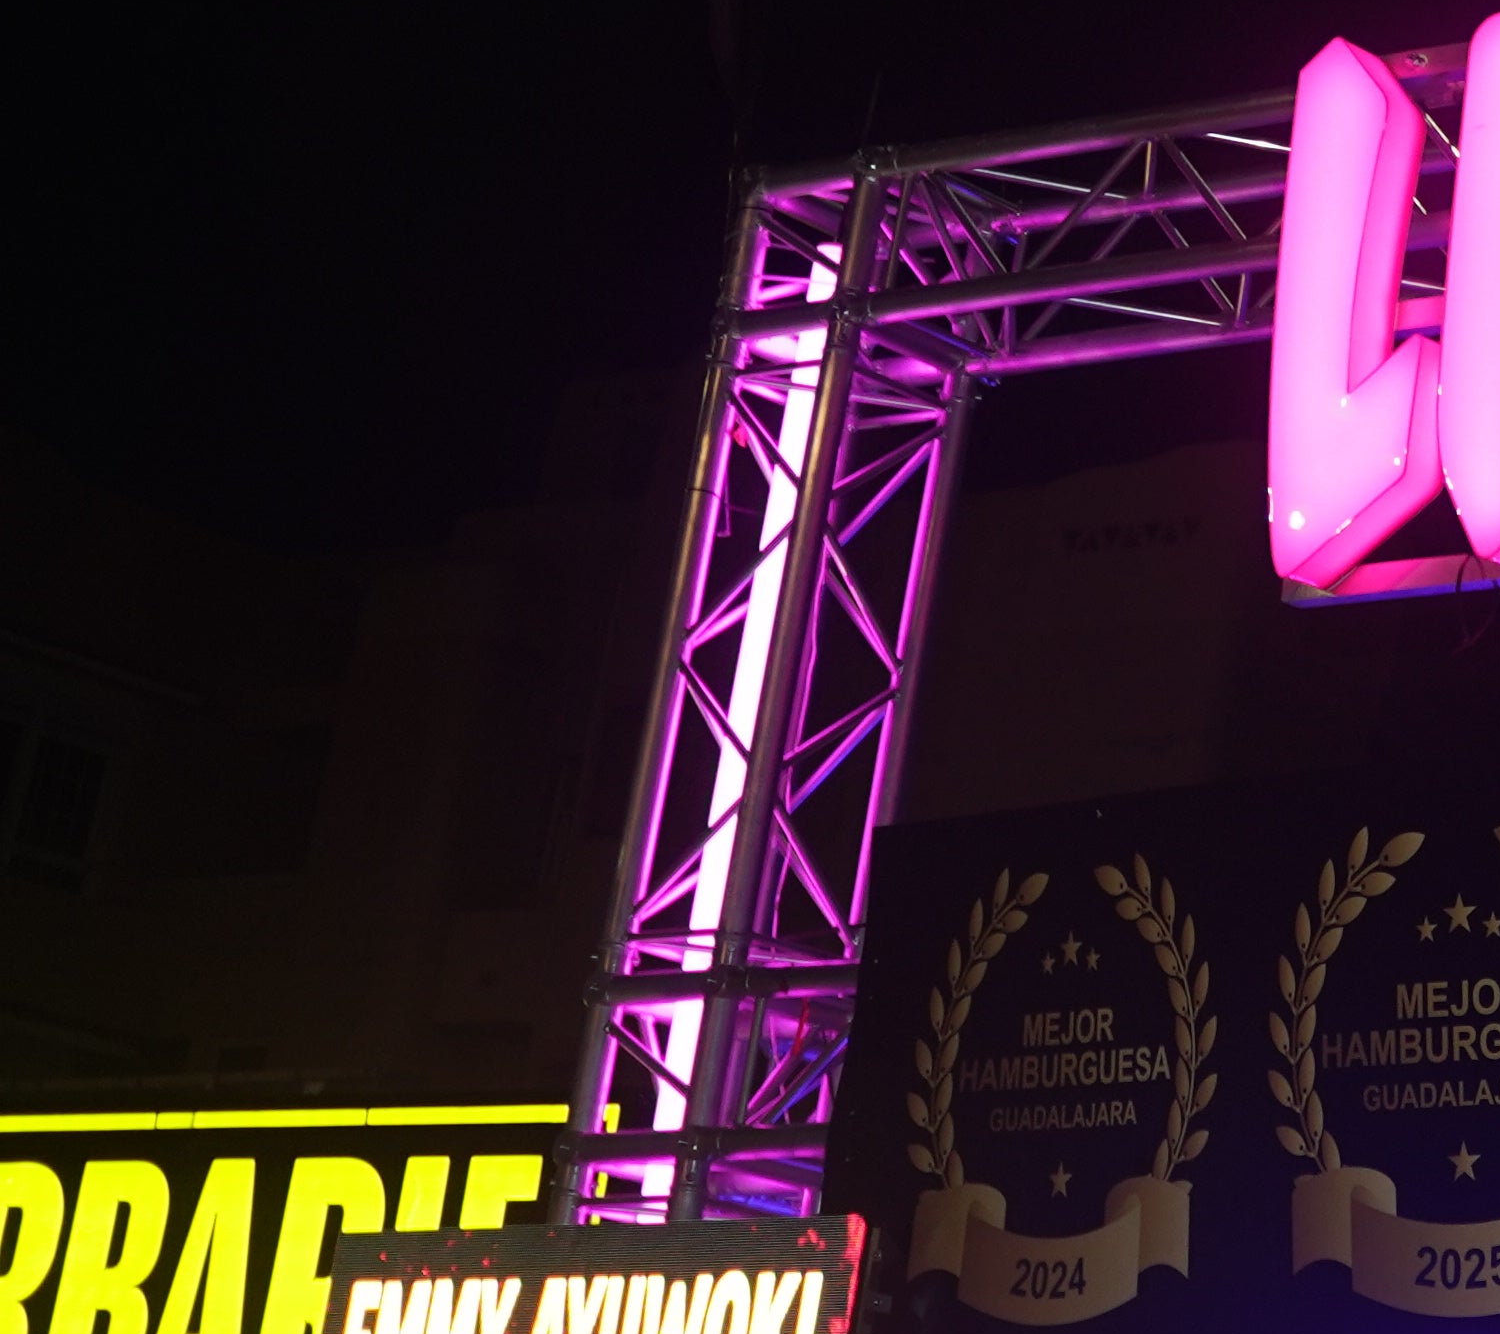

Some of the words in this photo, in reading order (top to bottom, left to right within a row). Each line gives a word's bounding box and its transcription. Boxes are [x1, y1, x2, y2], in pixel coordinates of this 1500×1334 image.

[1022, 1008, 1114, 1047] MEJOR
[959, 1045, 1171, 1092] HAMBURGUESA
[989, 1100, 1137, 1131] GUADALAJARA
[1010, 1257, 1086, 1299] 2024
